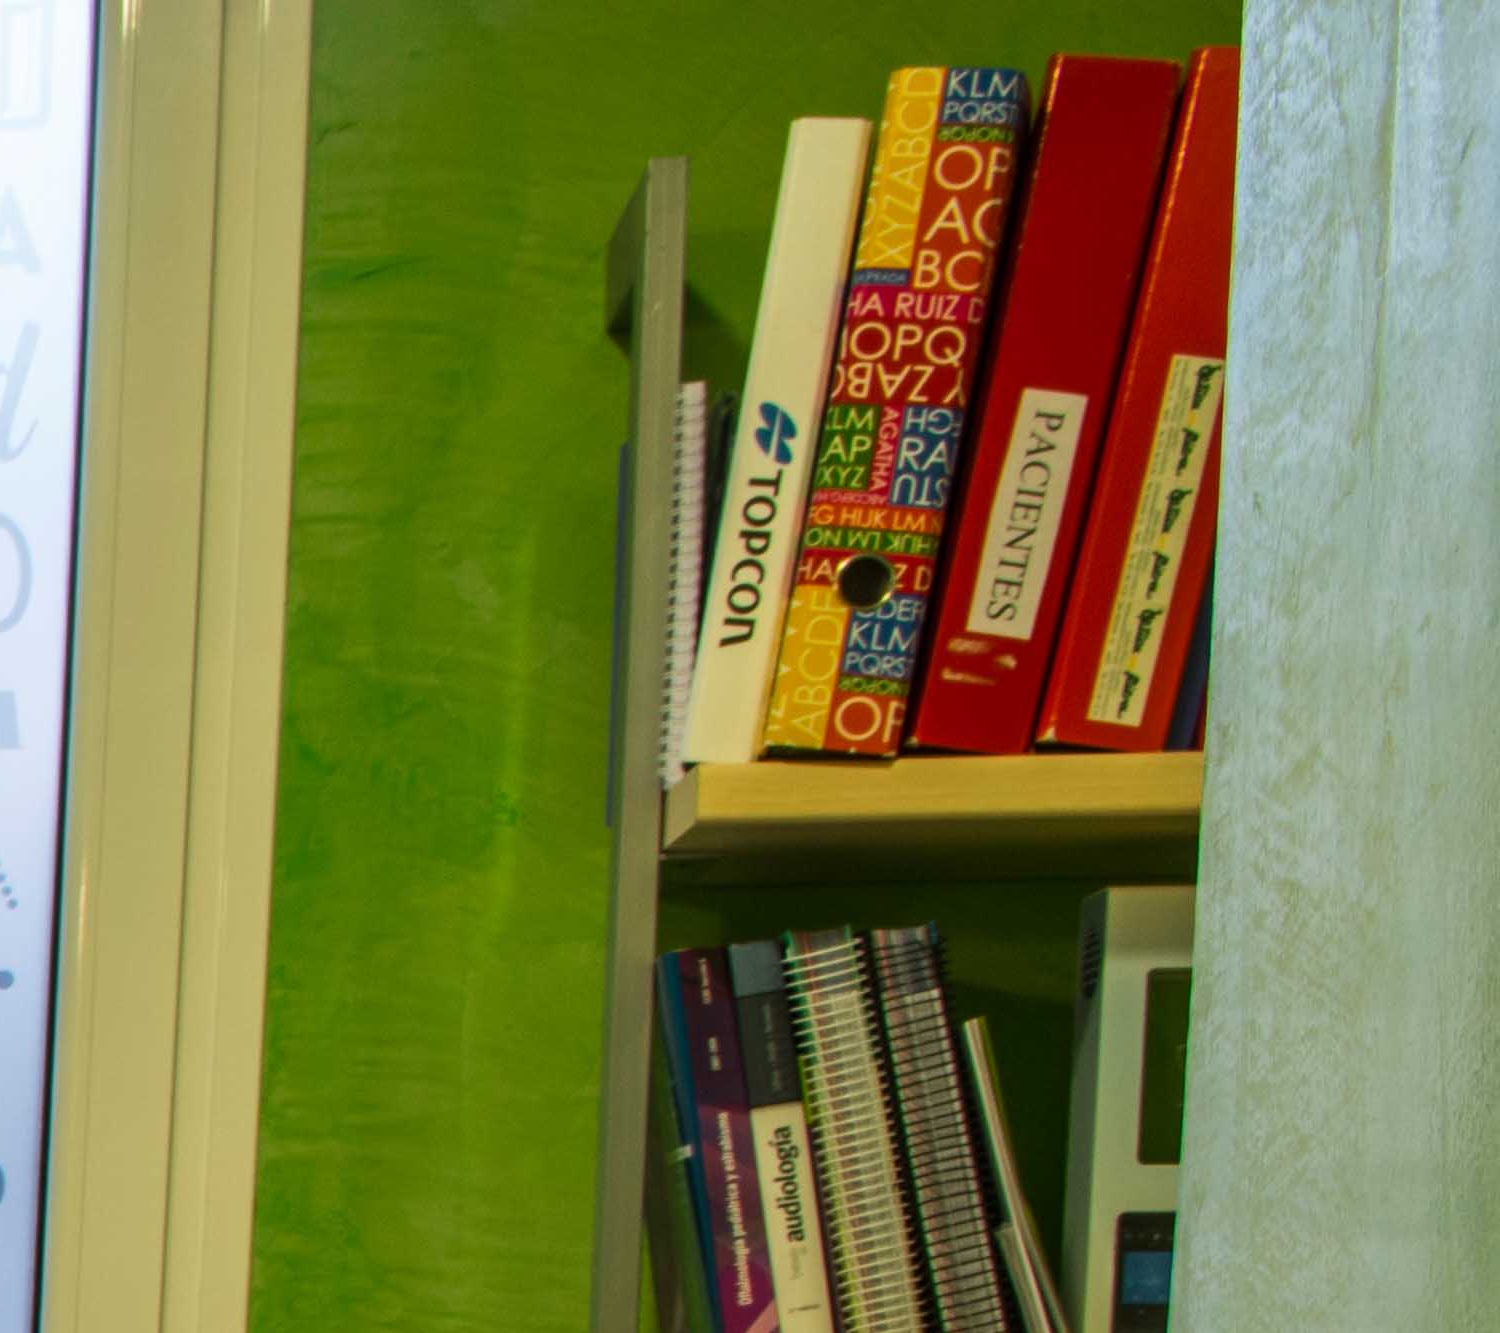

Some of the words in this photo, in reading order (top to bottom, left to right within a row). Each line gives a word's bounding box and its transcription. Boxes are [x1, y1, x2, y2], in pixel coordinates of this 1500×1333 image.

[894, 292, 962, 322] RUIZ
[868, 407, 901, 494] AGATHA
[719, 468, 784, 648] TOPCON
[985, 407, 1066, 625] PACIENTES
[767, 1125, 805, 1243] audiología
